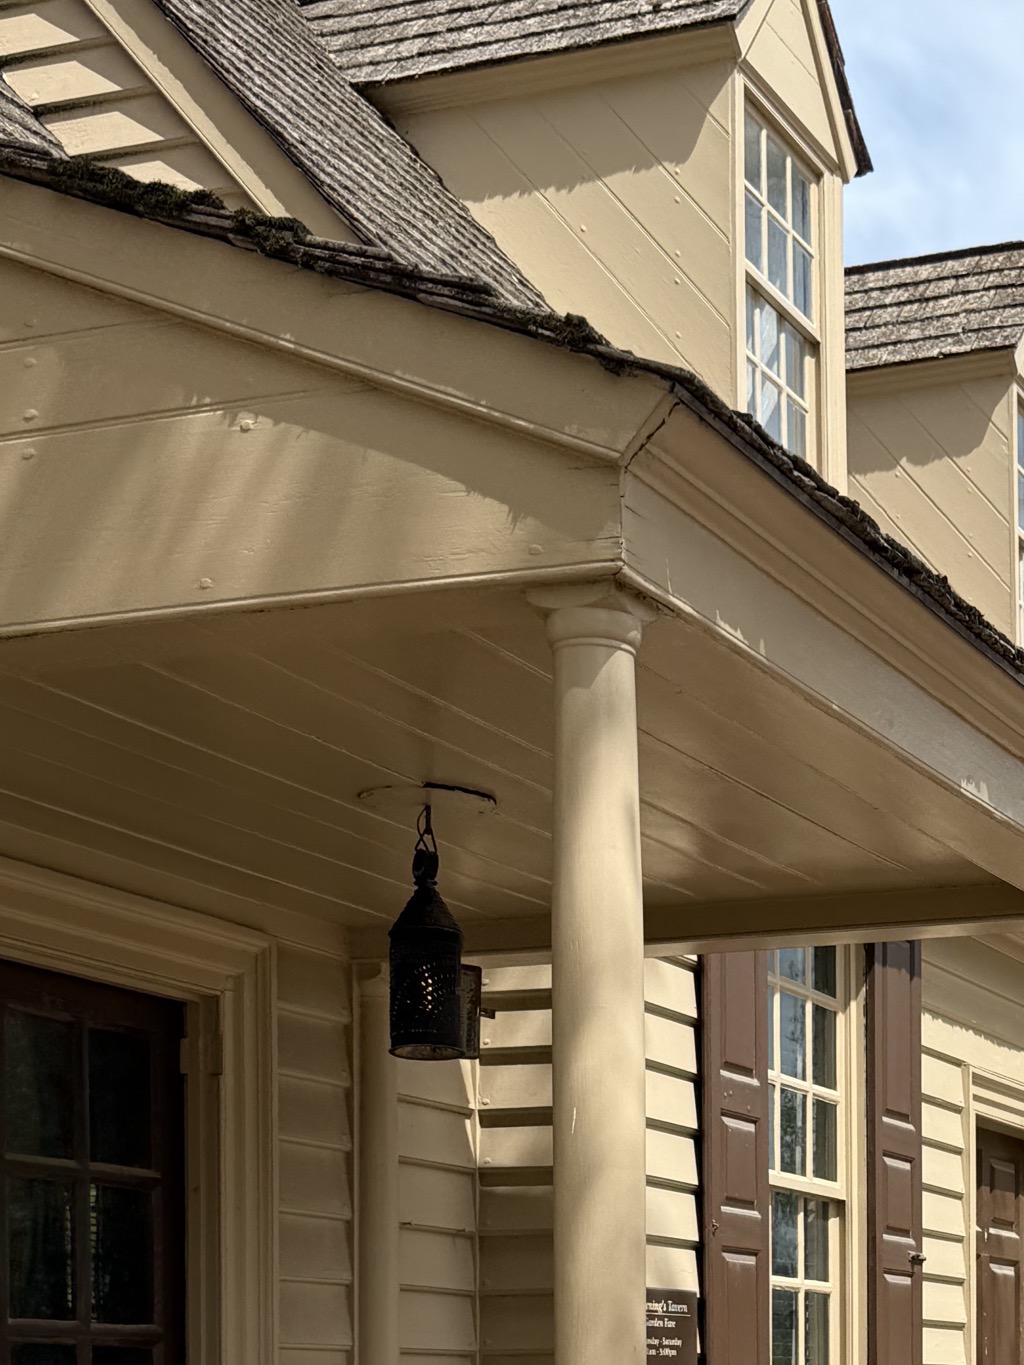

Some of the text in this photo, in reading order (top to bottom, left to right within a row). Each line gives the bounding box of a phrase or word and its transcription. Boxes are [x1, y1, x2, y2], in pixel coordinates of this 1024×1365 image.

[667, 1300, 688, 1312] Tavern
[664, 1318, 676, 1328] Fare
[662, 1337, 682, 1347] Saturday
